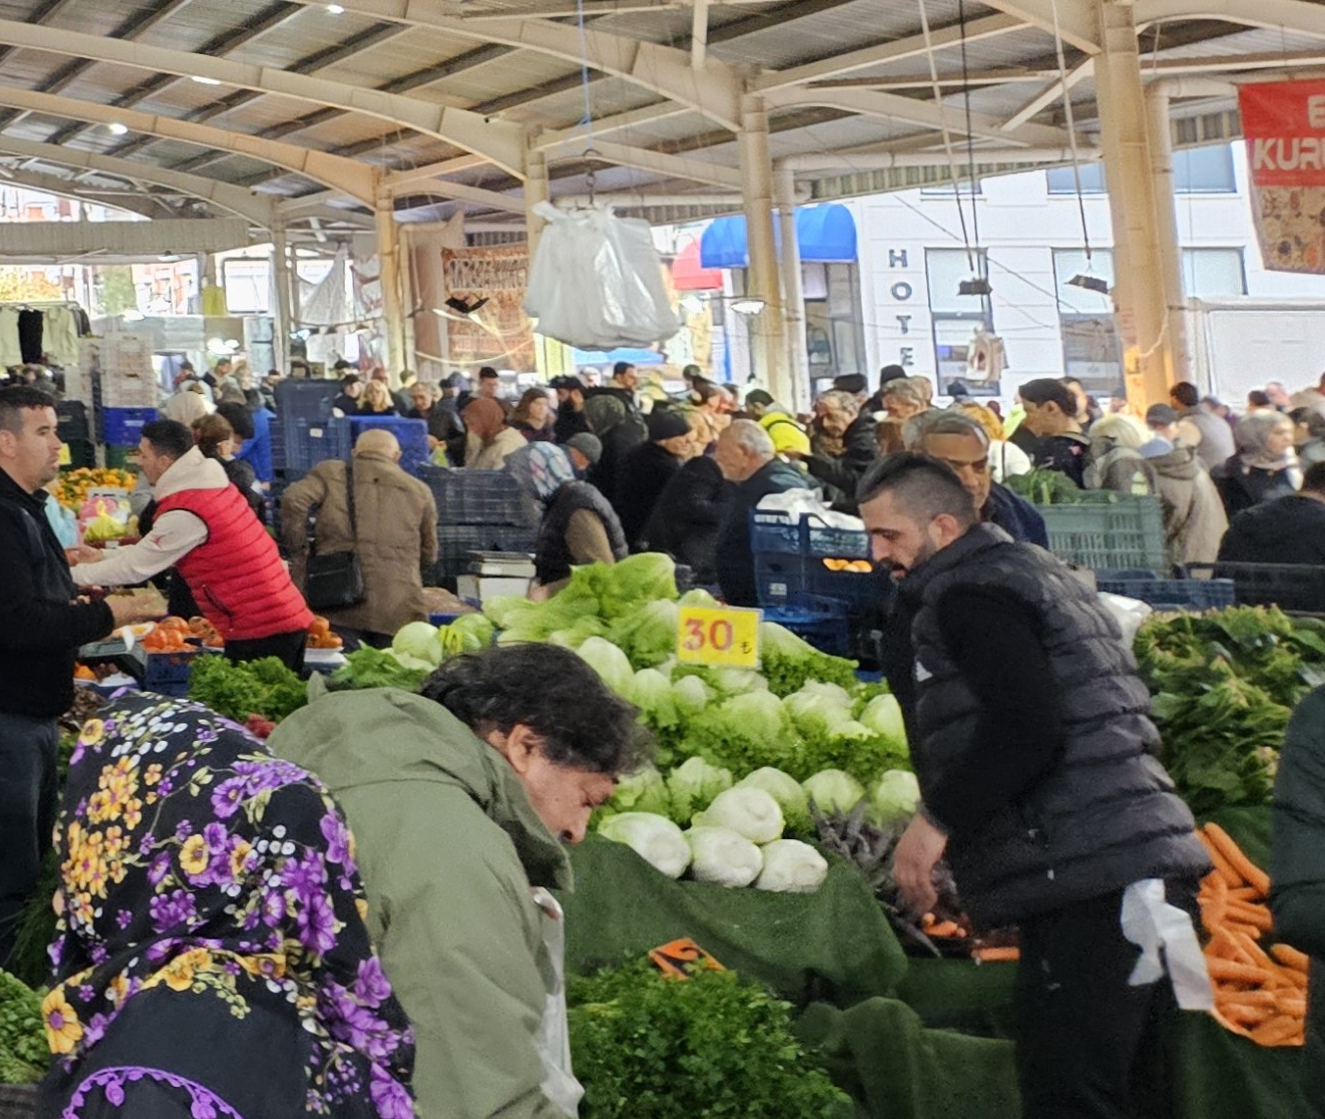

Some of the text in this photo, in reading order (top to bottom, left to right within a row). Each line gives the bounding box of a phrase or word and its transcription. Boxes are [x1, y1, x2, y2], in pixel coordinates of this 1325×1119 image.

[1253, 137, 1325, 171] KUR
[888, 249, 914, 366] HOTE
[683, 617, 733, 651] 30
